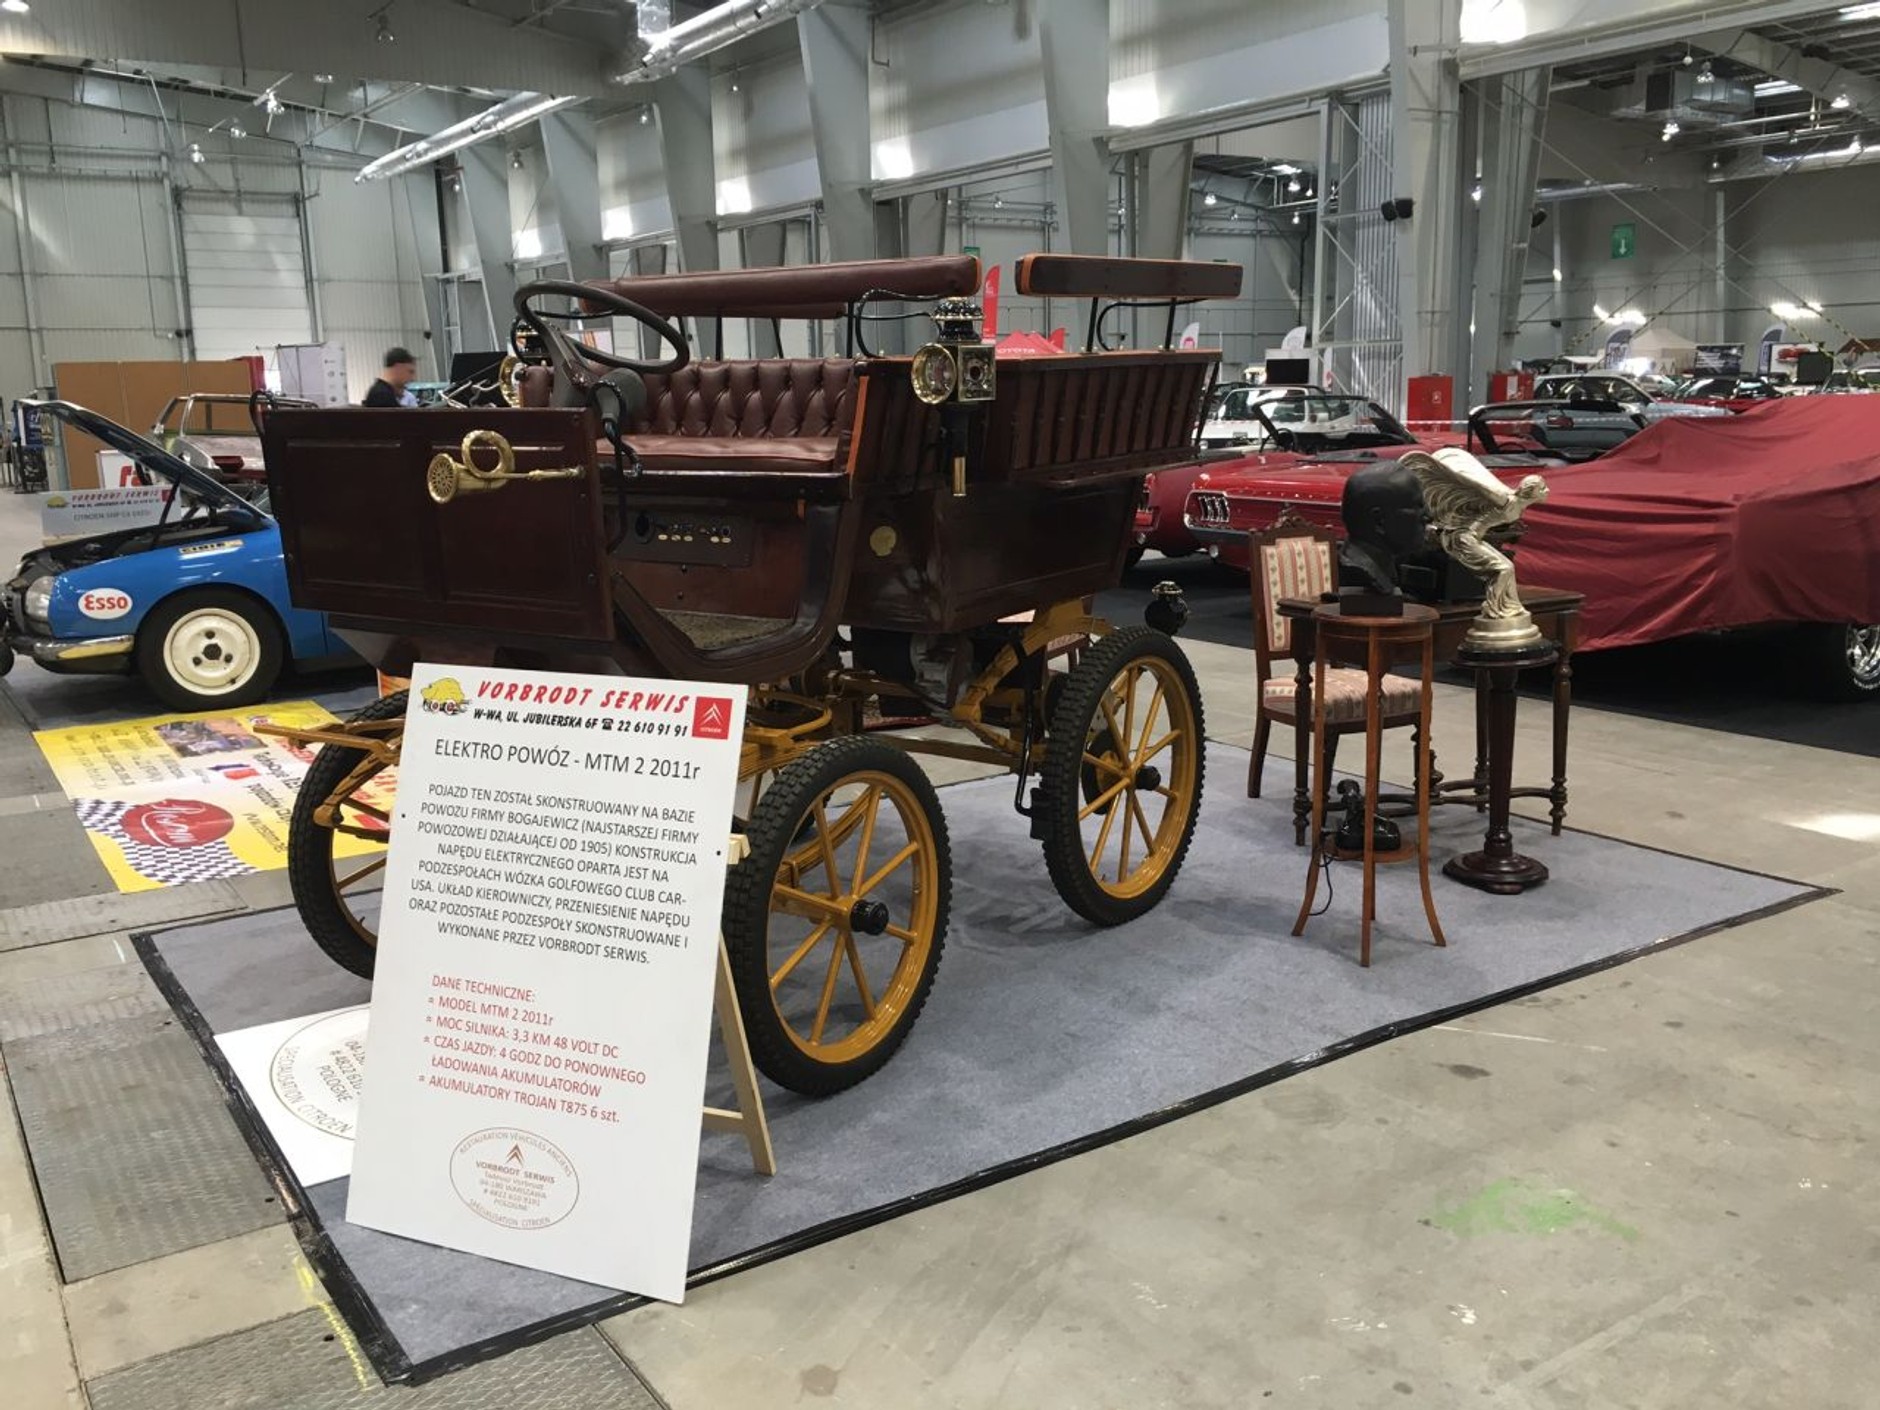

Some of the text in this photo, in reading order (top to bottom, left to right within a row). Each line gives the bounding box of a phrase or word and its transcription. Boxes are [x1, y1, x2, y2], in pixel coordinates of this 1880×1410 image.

[84, 594, 129, 611] Esso
[477, 680, 690, 714] VORBRODT SERWIS
[523, 712, 582, 728] JUBILERSKA
[584, 717, 599, 729] 6F
[617, 719, 631, 732] 22
[634, 721, 655, 734] 610
[658, 723, 671, 735] 91
[674, 725, 688, 737] 91
[435, 739, 503, 761] ELEKTRO
[508, 745, 570, 767] POWÓZ
[585, 752, 630, 773] MTM
[634, 757, 645, 775] 2
[650, 758, 701, 780] 2011r
[420, 802, 700, 845] POWOZU FIRMY BOGAJEWICZ (NAJSTARSZEJ FIRMY
[428, 783, 696, 824] POJAZD TEN ZOSTAŁ SKONSTRUOWANY NA BAZIE
[417, 820, 698, 866] POWOZOWEJ DZIAŁAJĄCEJ OD 1905) KONSTRUKCJA
[437, 843, 669, 883] NAPĘDU ELEKTRYCZNEGO OPARTA JEST NA
[411, 878, 691, 928] USA. UKŁAD KIEROWNICZY, PRZENIESIENIE NAPĘDU
[418, 860, 687, 906] PODZESPOŁACH WÓZKA GOLFOWEGO CLUB CAR-
[408, 898, 689, 949] ORAZ POZOSTAŁE PODZESPOŁY SKONSTRUOWANE I
[437, 921, 651, 964] WYKONANE PRZEZ VORBRODT SERWIS.
[431, 975, 536, 1003] DANE TECHNICZNE:
[438, 996, 554, 1026] MODEL MTM 2 2011r
[436, 1016, 620, 1059] MOC SILNIKA: 3,3 KM 48 VOLT DC
[431, 1055, 603, 1098] ŁADOWANIA AKUMULATORÓW
[433, 1035, 647, 1085] CZAS JAZDY: 4 GODZ DO PONOWNEGO
[429, 1075, 620, 1123] AKUMULATORY TROJAN T875 6 szt.
[475, 1161, 555, 1184] VORBRODT SERWIS
